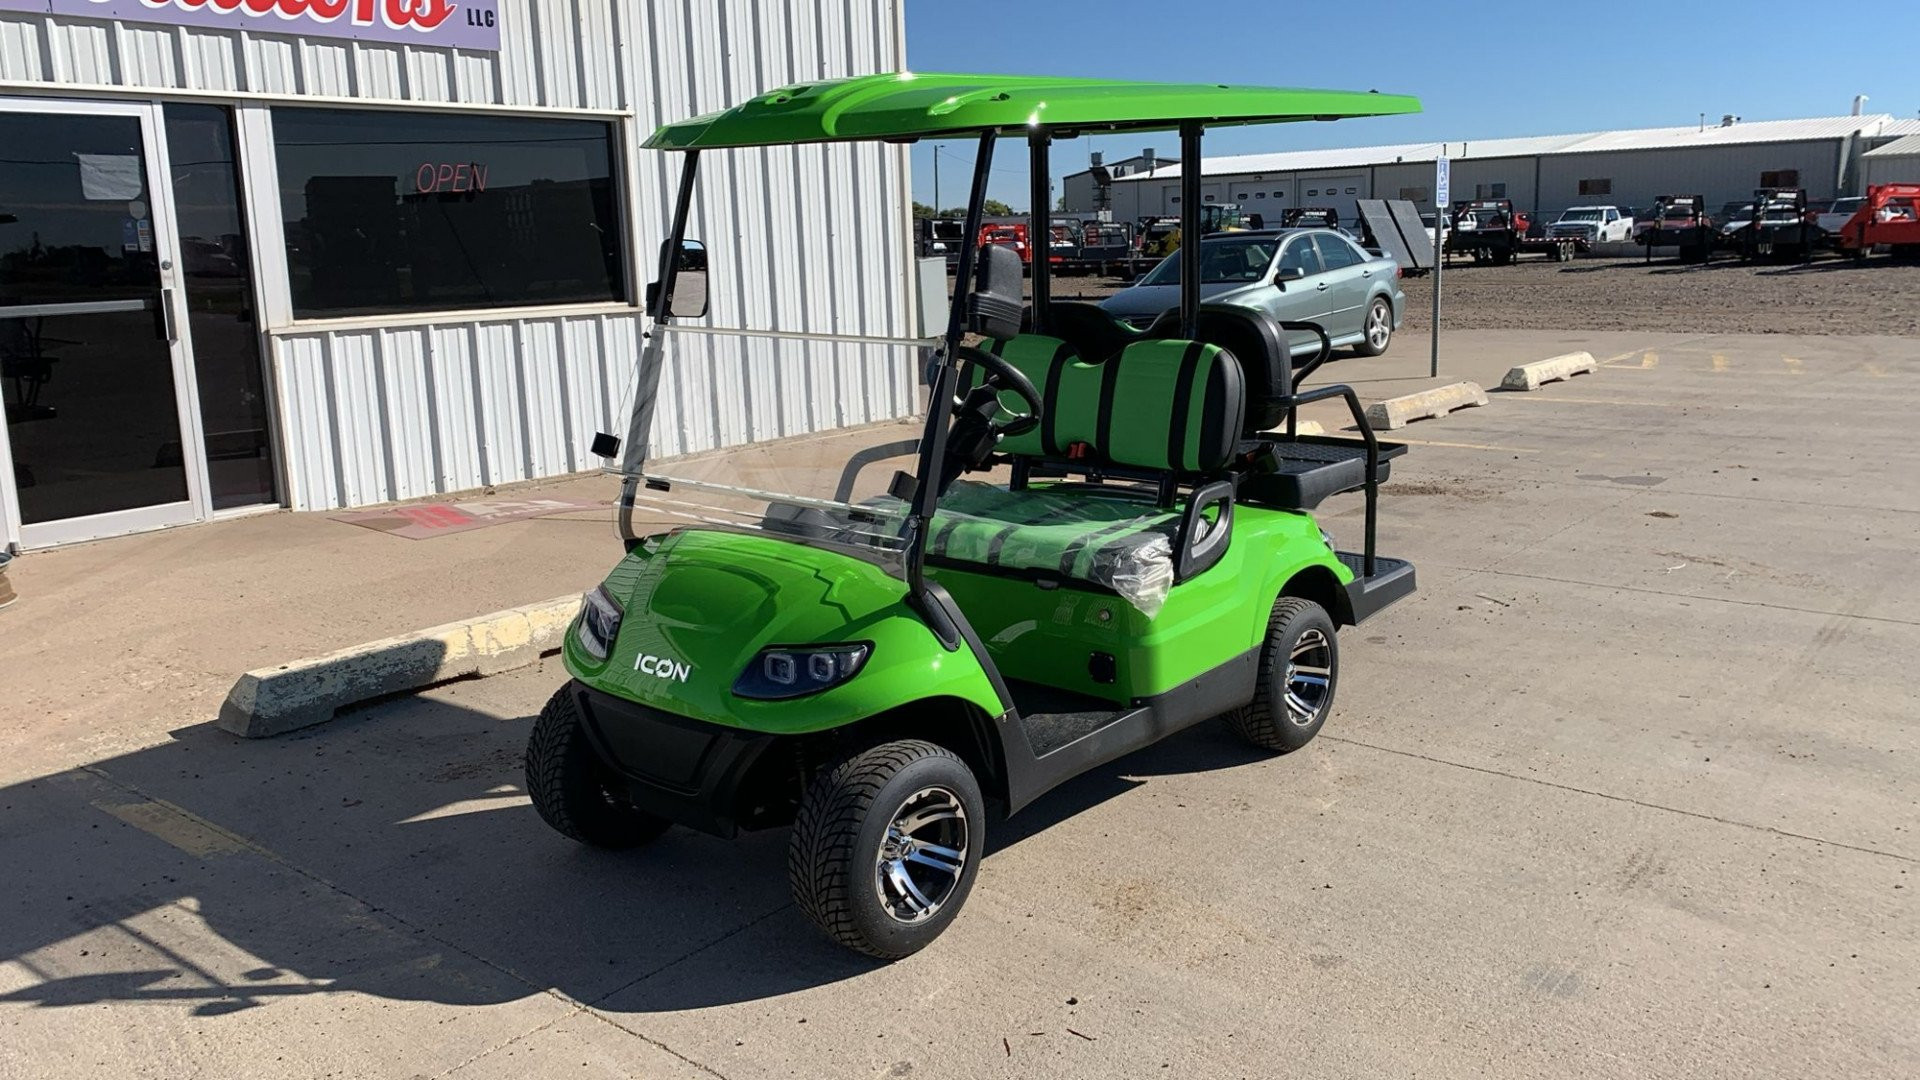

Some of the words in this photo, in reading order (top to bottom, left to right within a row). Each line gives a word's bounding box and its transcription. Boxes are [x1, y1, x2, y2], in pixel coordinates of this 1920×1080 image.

[466, 8, 495, 28] LLC
[417, 163, 488, 193] OPEN
[633, 652, 692, 684] ICON
